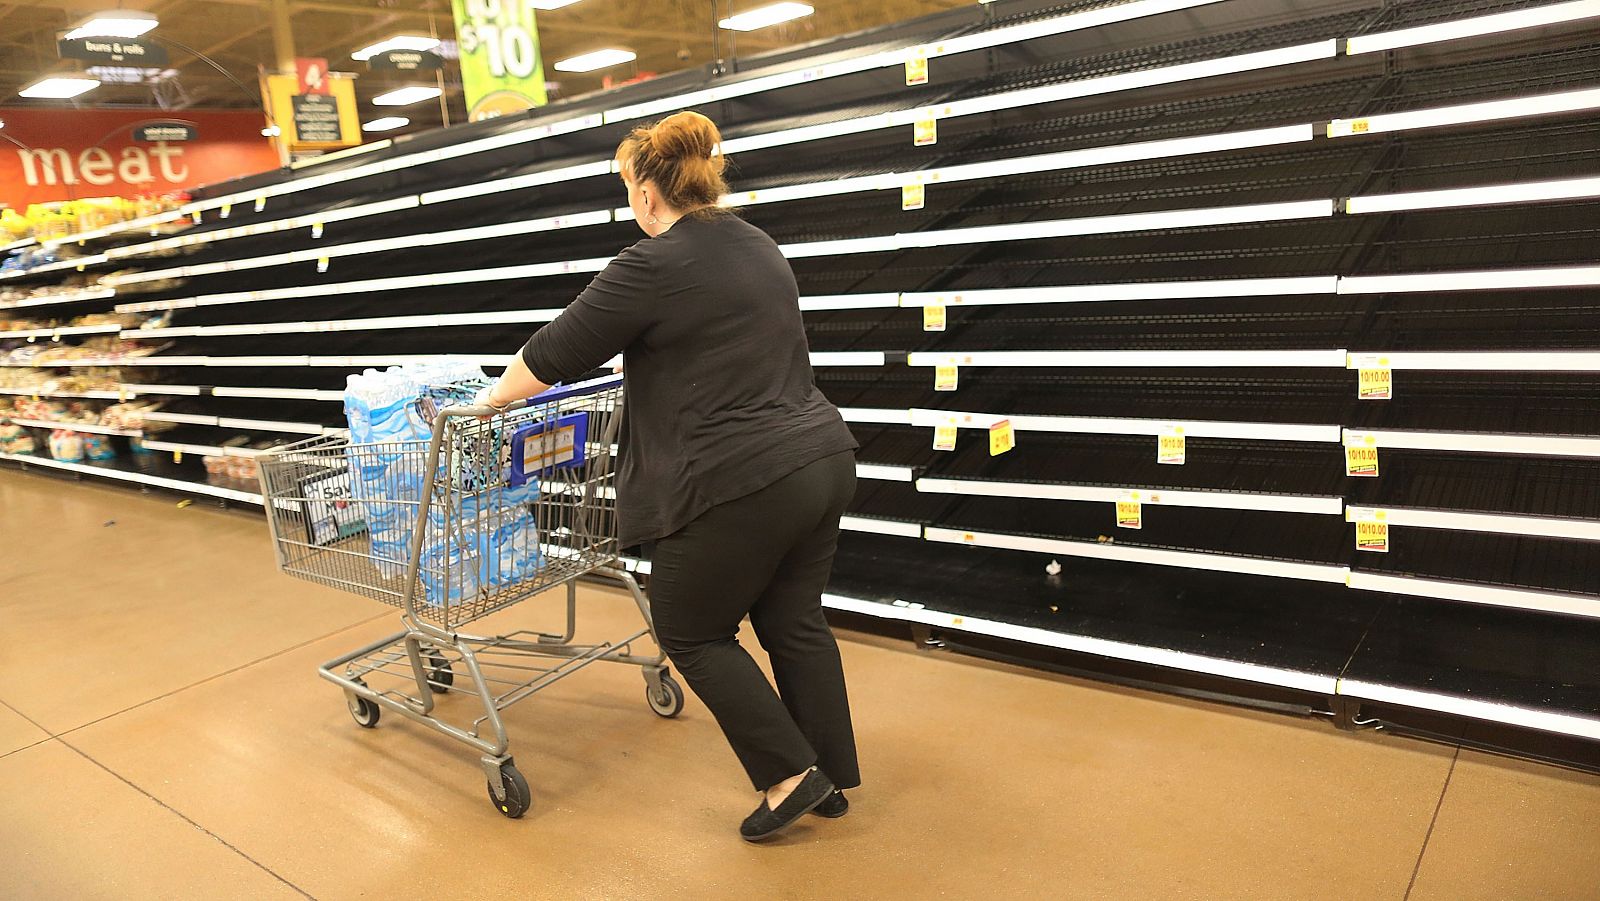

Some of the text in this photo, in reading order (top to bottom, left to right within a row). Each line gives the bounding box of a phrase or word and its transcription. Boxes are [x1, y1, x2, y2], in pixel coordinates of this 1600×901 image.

[85, 40, 145, 56] buns & rolls
[460, 24, 537, 78] $10
[304, 64, 323, 90] 4
[17, 141, 189, 186] meat
[1360, 371, 1390, 383] 10/10.00
[1347, 449, 1377, 461] 10/10.00
[1357, 523, 1387, 536] 10/10.00
